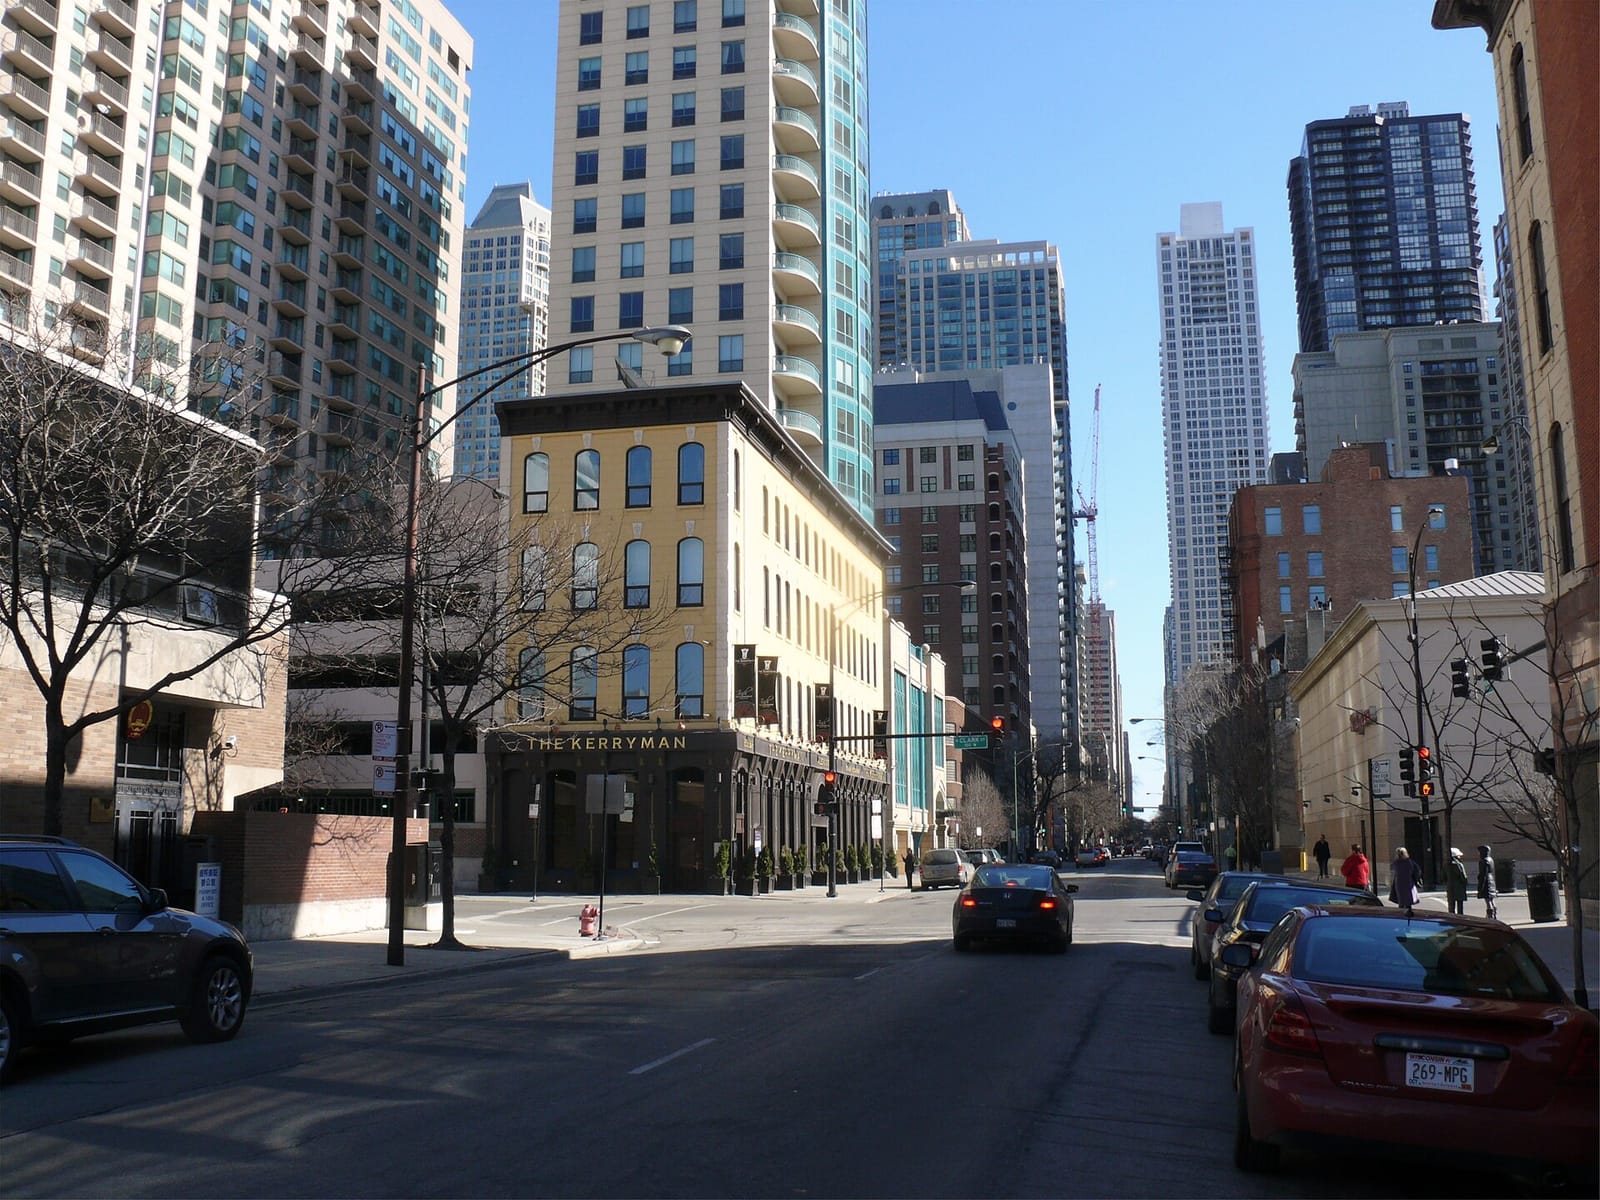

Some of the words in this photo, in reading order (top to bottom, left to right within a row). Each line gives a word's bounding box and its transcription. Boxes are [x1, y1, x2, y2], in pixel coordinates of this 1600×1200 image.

[527, 737, 563, 750] THE
[571, 736, 686, 750] KERRYMAN
[1412, 1062, 1468, 1084] 269-MPG
